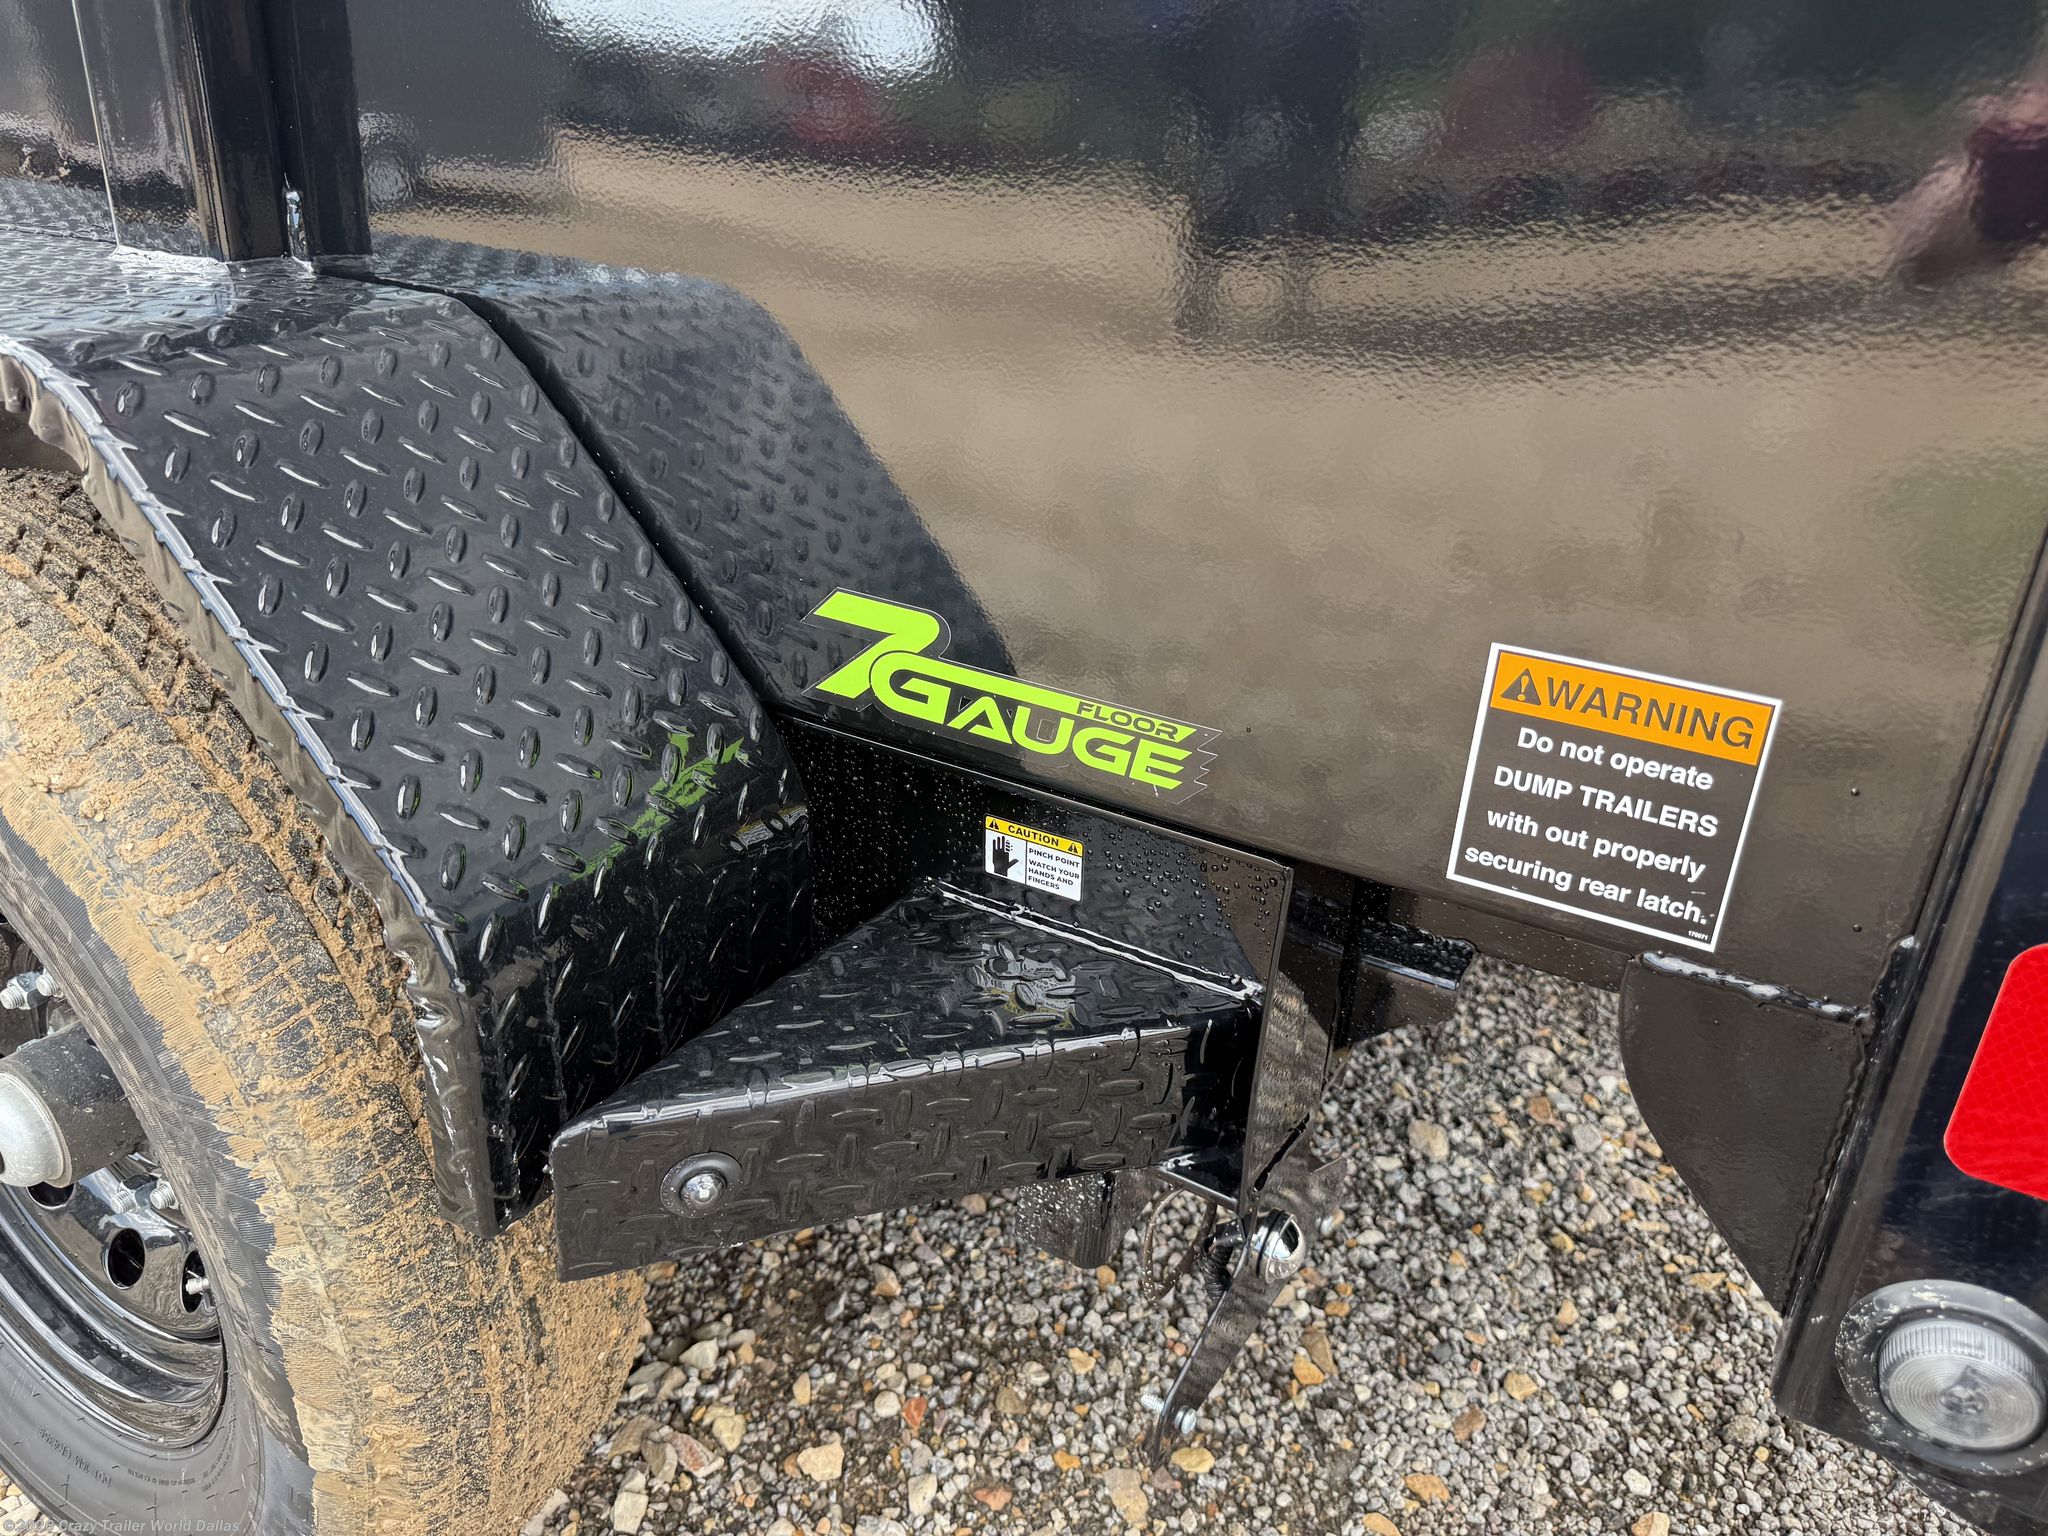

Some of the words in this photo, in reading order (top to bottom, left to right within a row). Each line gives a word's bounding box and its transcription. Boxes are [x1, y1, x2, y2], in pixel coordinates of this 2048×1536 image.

[814, 591, 940, 699] 7
[870, 652, 1193, 790] GAUGE
[1076, 701, 1179, 741] FLOOR
[1547, 676, 1754, 750] WARNING
[1517, 726, 1553, 753] Do
[1560, 741, 1605, 766] not
[1609, 752, 1714, 791] operate
[1493, 765, 1573, 800] DUMP
[1579, 784, 1719, 838] TRAILERS
[1008, 825, 1060, 847] CAUTION
[1028, 847, 1053, 860] PINCH
[1055, 855, 1080, 868] POINT
[1486, 808, 1538, 837] with
[1545, 823, 1589, 850] out
[1592, 836, 1706, 884] properly
[1028, 858, 1057, 873] WATCH
[1058, 867, 1080, 880] YOUR
[1028, 867, 1055, 881] HANDS
[1056, 875, 1074, 886] AND
[1028, 875, 1060, 890] FINGERS
[1464, 846, 1573, 892] securing
[1578, 877, 1632, 903] rear
[1636, 888, 1707, 925] latch.
